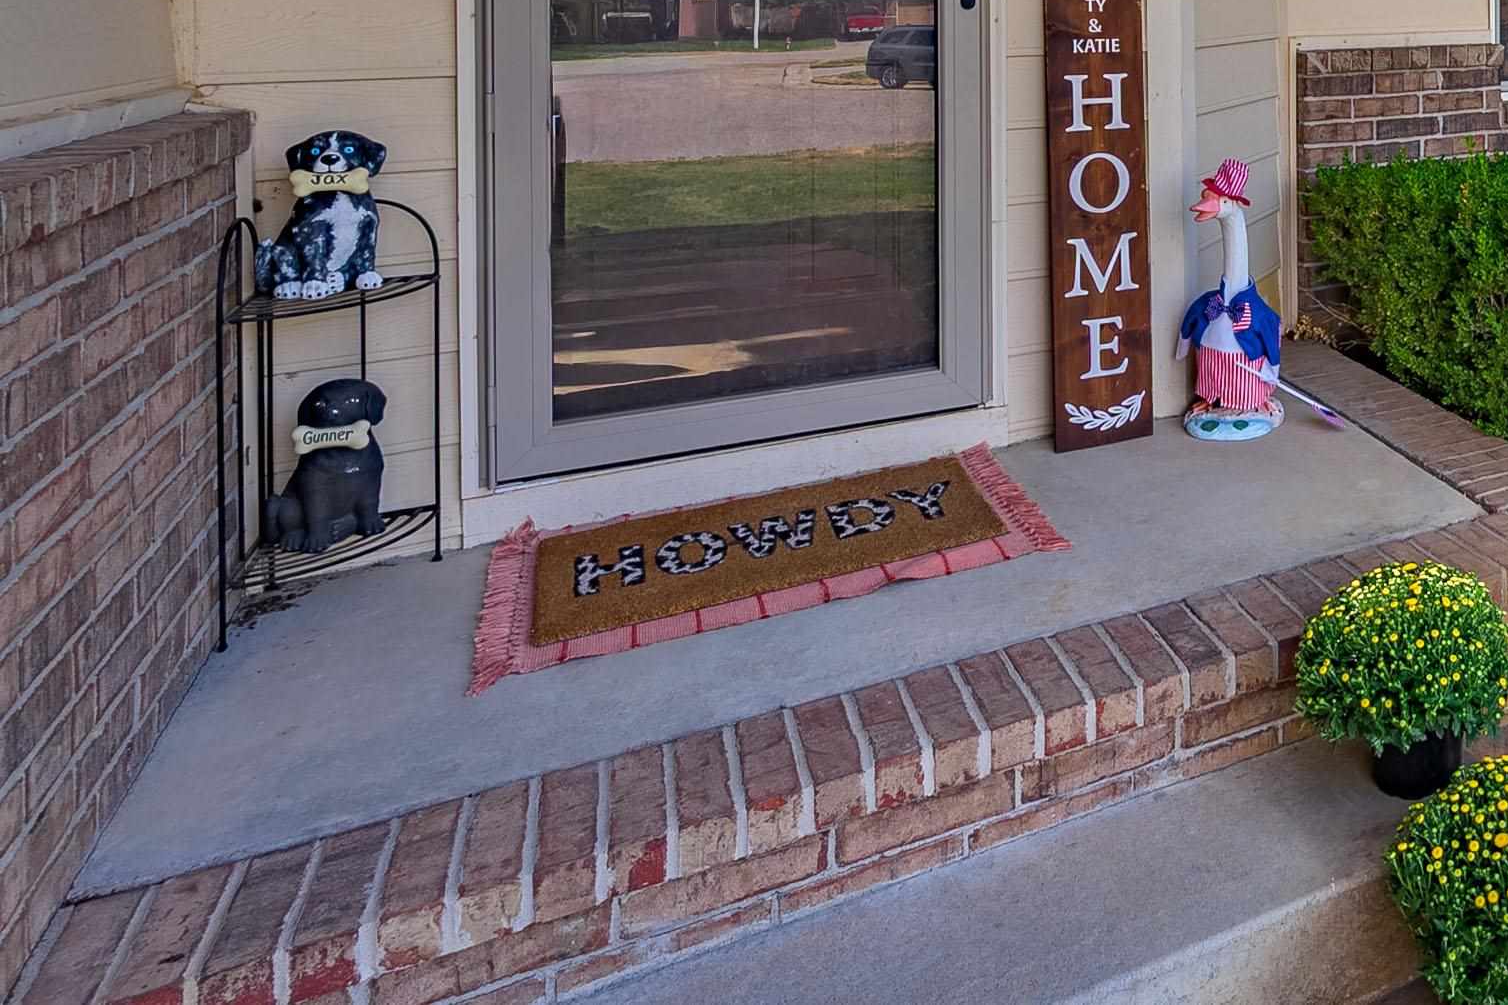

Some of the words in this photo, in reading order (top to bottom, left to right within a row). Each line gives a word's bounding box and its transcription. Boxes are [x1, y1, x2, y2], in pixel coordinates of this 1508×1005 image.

[1088, 18, 1102, 33] &
[1072, 38, 1120, 53] KATIE
[311, 174, 349, 185] Jax
[1064, 72, 1140, 380] HOME
[303, 430, 353, 445] Gunner
[573, 479, 952, 598] HOWDY
